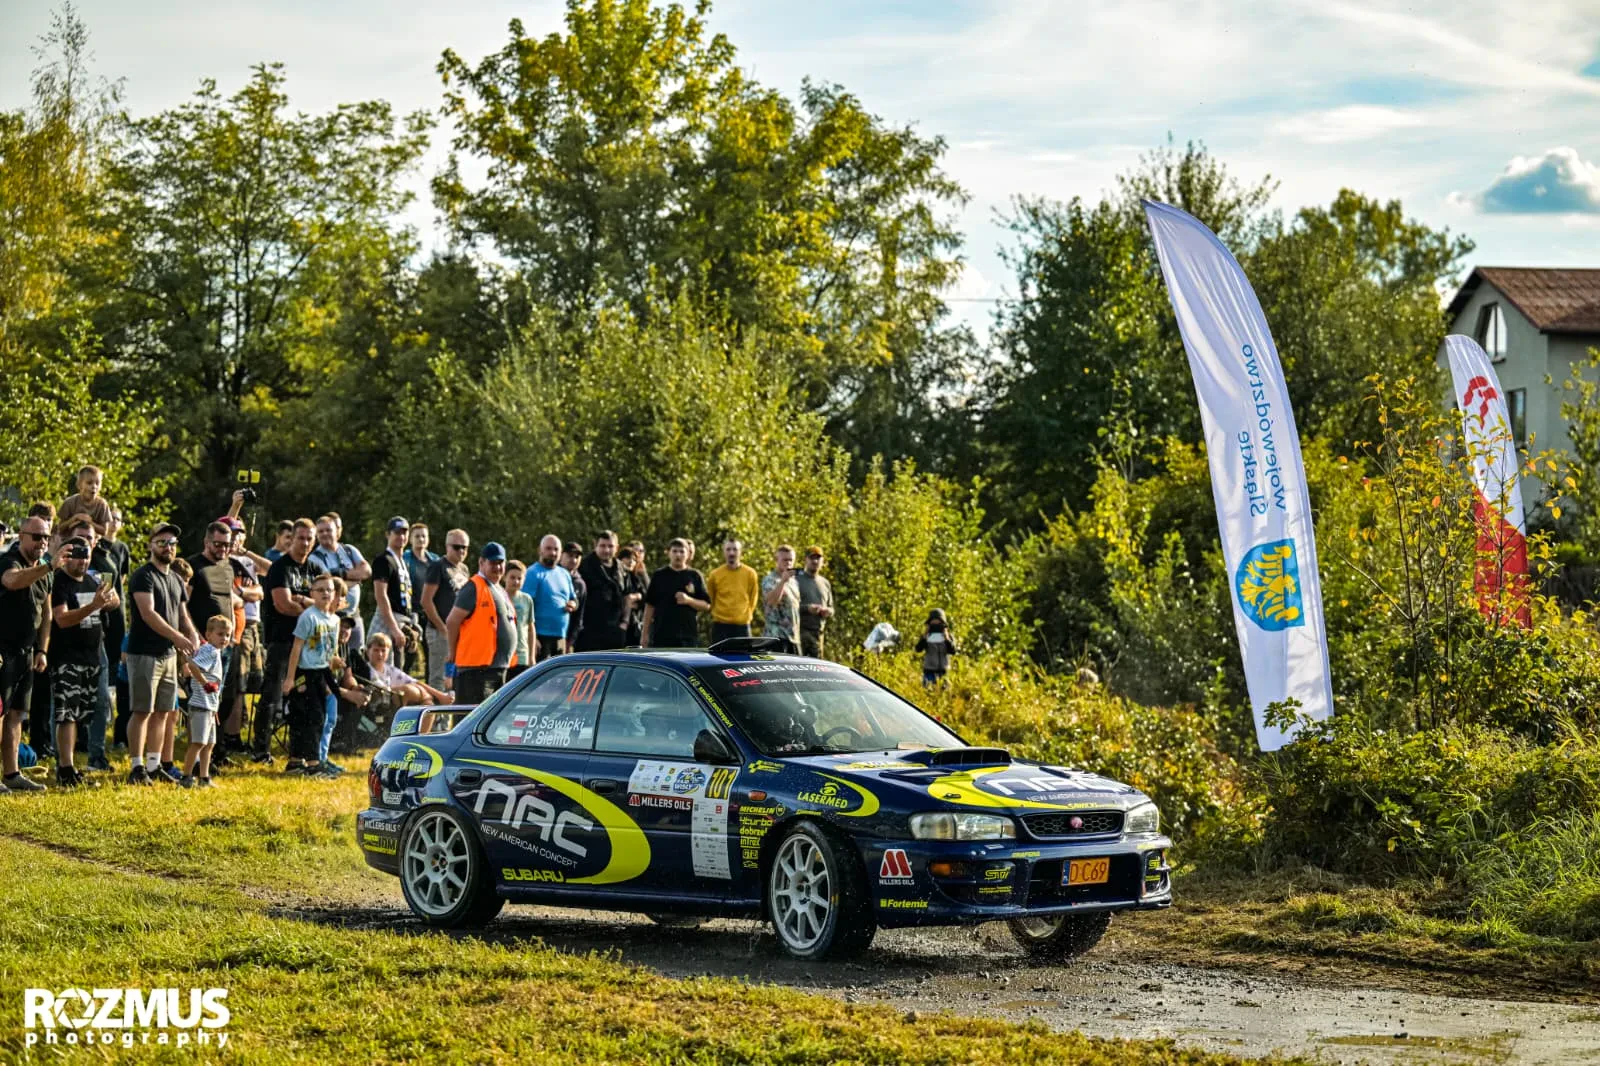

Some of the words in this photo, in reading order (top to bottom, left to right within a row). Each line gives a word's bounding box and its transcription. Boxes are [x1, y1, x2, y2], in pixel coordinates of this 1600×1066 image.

[739, 665, 784, 675] MILLERS
[567, 668, 606, 704] 101
[708, 768, 738, 799] 101
[641, 797, 673, 809] MILLERS
[674, 800, 691, 810] OILS
[796, 791, 848, 809] LASERMED
[739, 806, 775, 814] MICHELIN
[480, 824, 498, 837] NEW
[499, 831, 539, 855] AMERICAN
[539, 848, 578, 869] CONCEPT
[502, 868, 564, 882] SUBARU
[1082, 861, 1107, 882] C69
[887, 899, 929, 908] Fortemix
